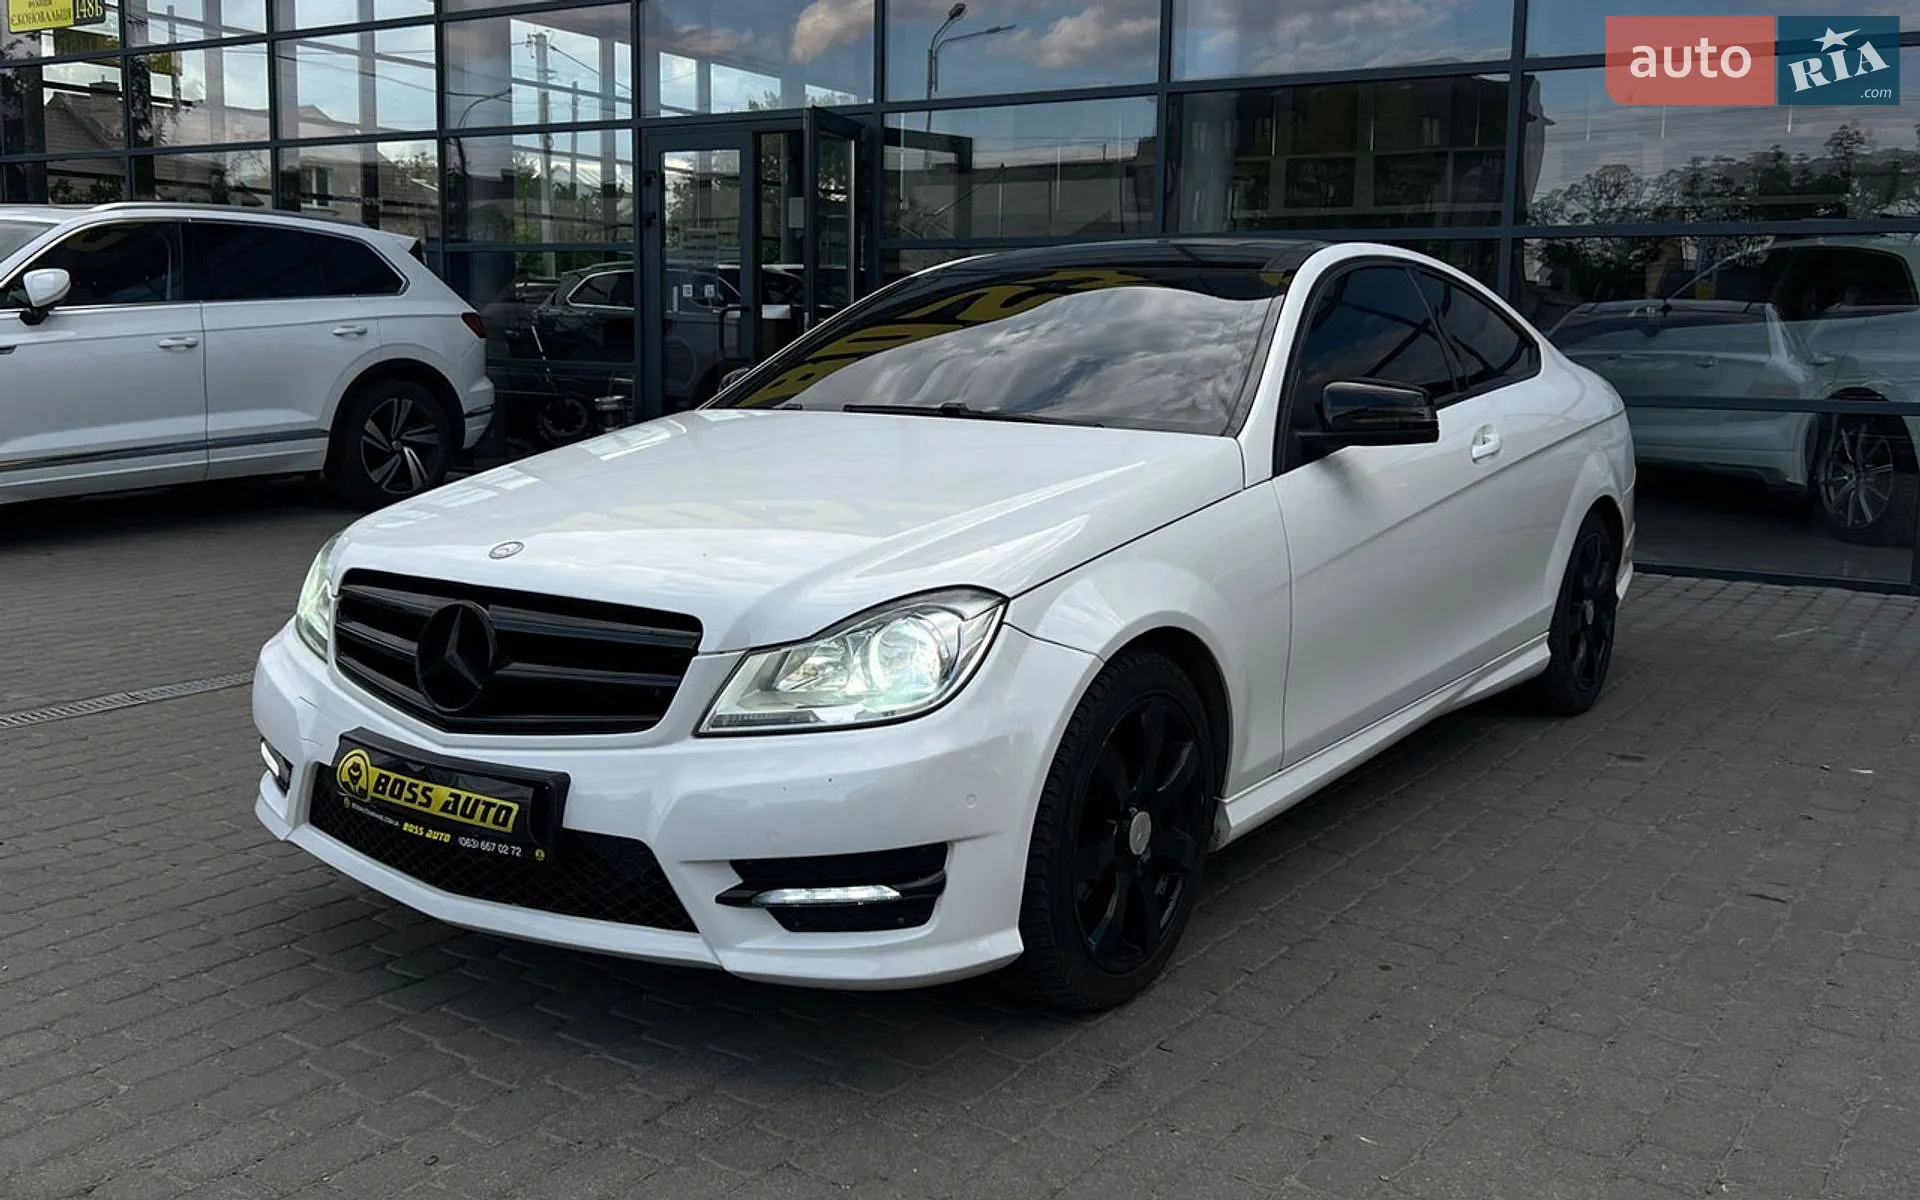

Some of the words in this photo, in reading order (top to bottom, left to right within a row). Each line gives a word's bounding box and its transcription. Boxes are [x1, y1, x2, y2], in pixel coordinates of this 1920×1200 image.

[373, 773, 435, 808] BOSS
[440, 791, 514, 828] AUTO
[402, 822, 424, 836] BOSS
[425, 829, 451, 843] AUTO
[457, 836, 479, 849] (063)
[480, 840, 496, 852] 667
[497, 844, 509, 855] 02
[510, 846, 522, 857] 72
